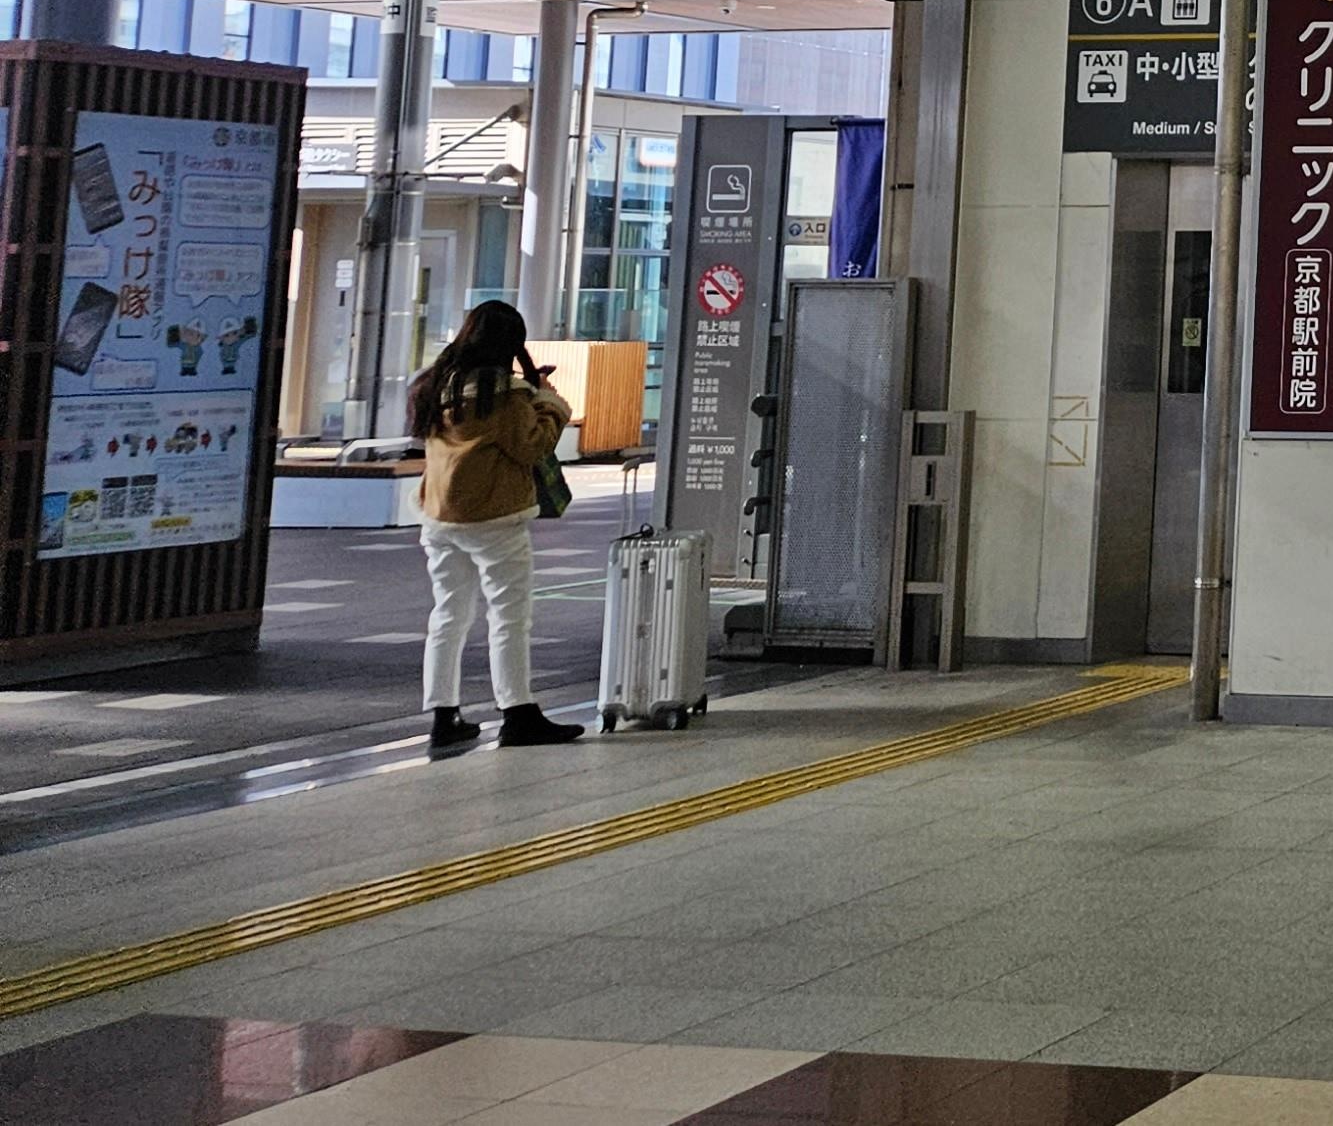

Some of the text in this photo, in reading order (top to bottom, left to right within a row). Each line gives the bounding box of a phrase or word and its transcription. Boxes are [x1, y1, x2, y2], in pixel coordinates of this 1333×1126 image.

[1083, 54, 1123, 67] TAXI
[1132, 122, 1190, 135] Medium
[804, 222, 826, 233] 入口
[1289, 255, 1322, 409] 京都駅前院
